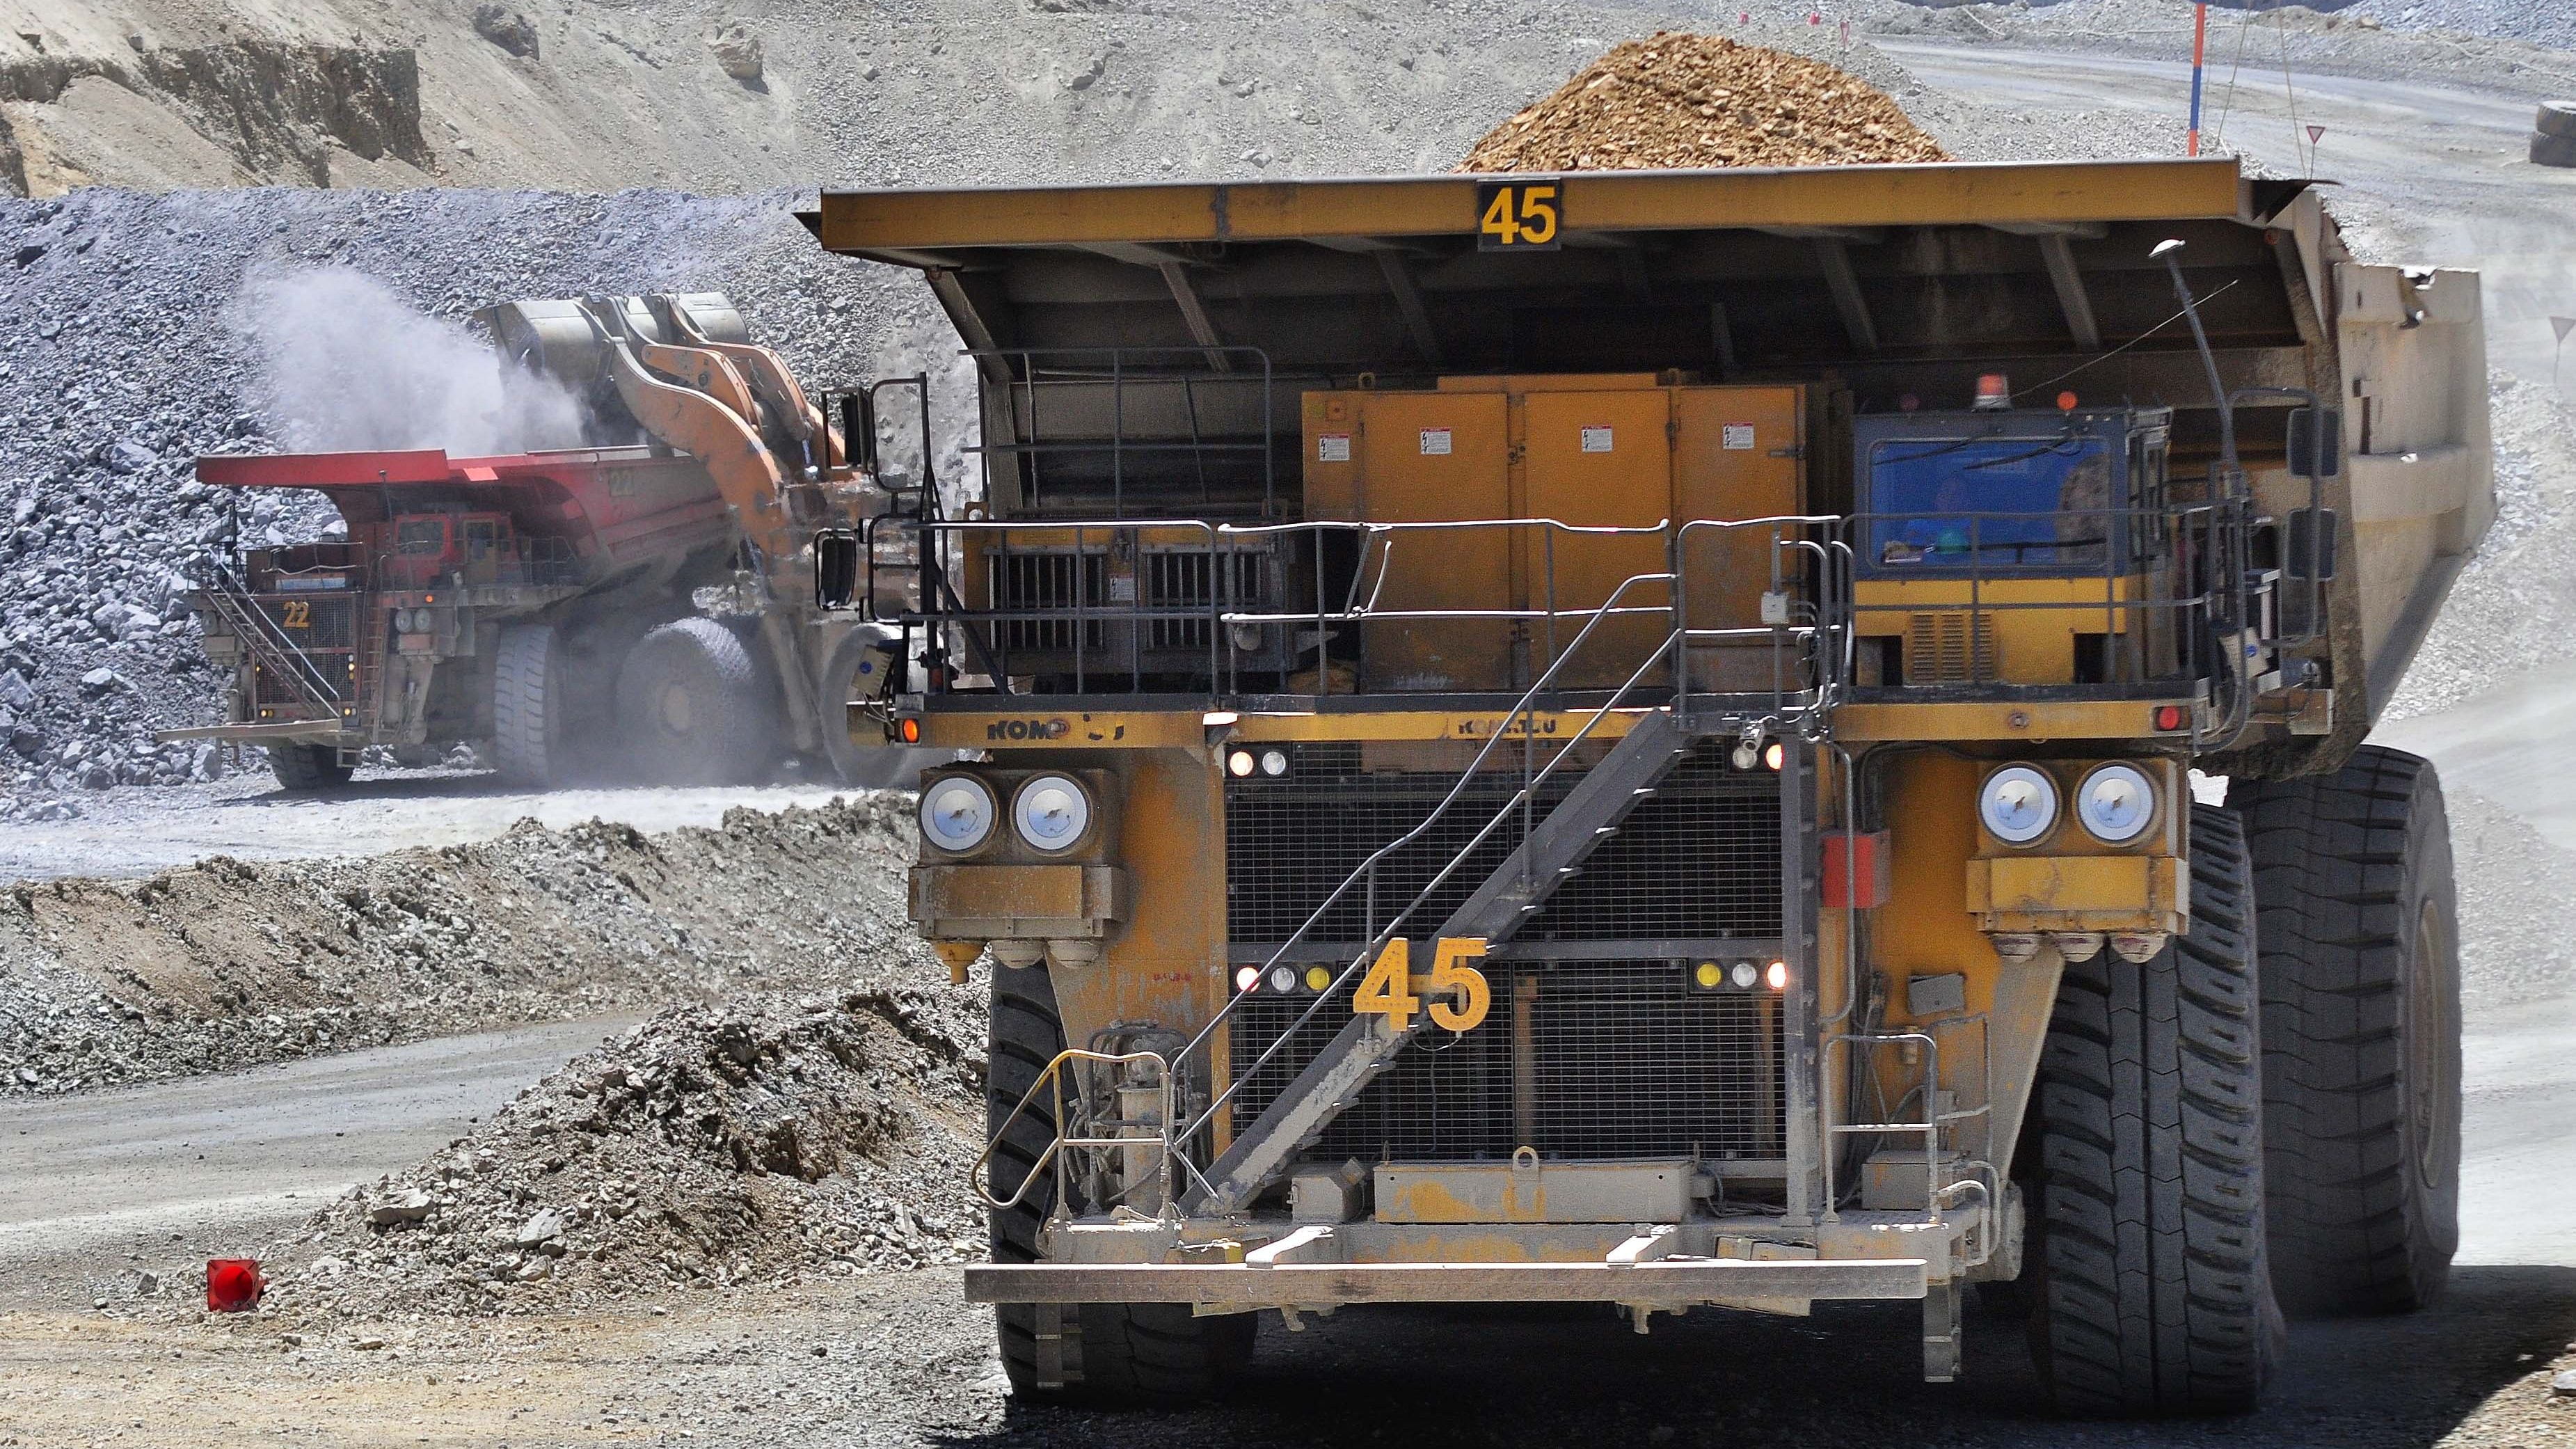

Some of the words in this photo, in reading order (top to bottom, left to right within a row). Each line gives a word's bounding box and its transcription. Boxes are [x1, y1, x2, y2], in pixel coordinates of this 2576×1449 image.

[1481, 187, 1557, 244] 45
[283, 601, 311, 628] 22
[1353, 937, 1490, 1031] 45
